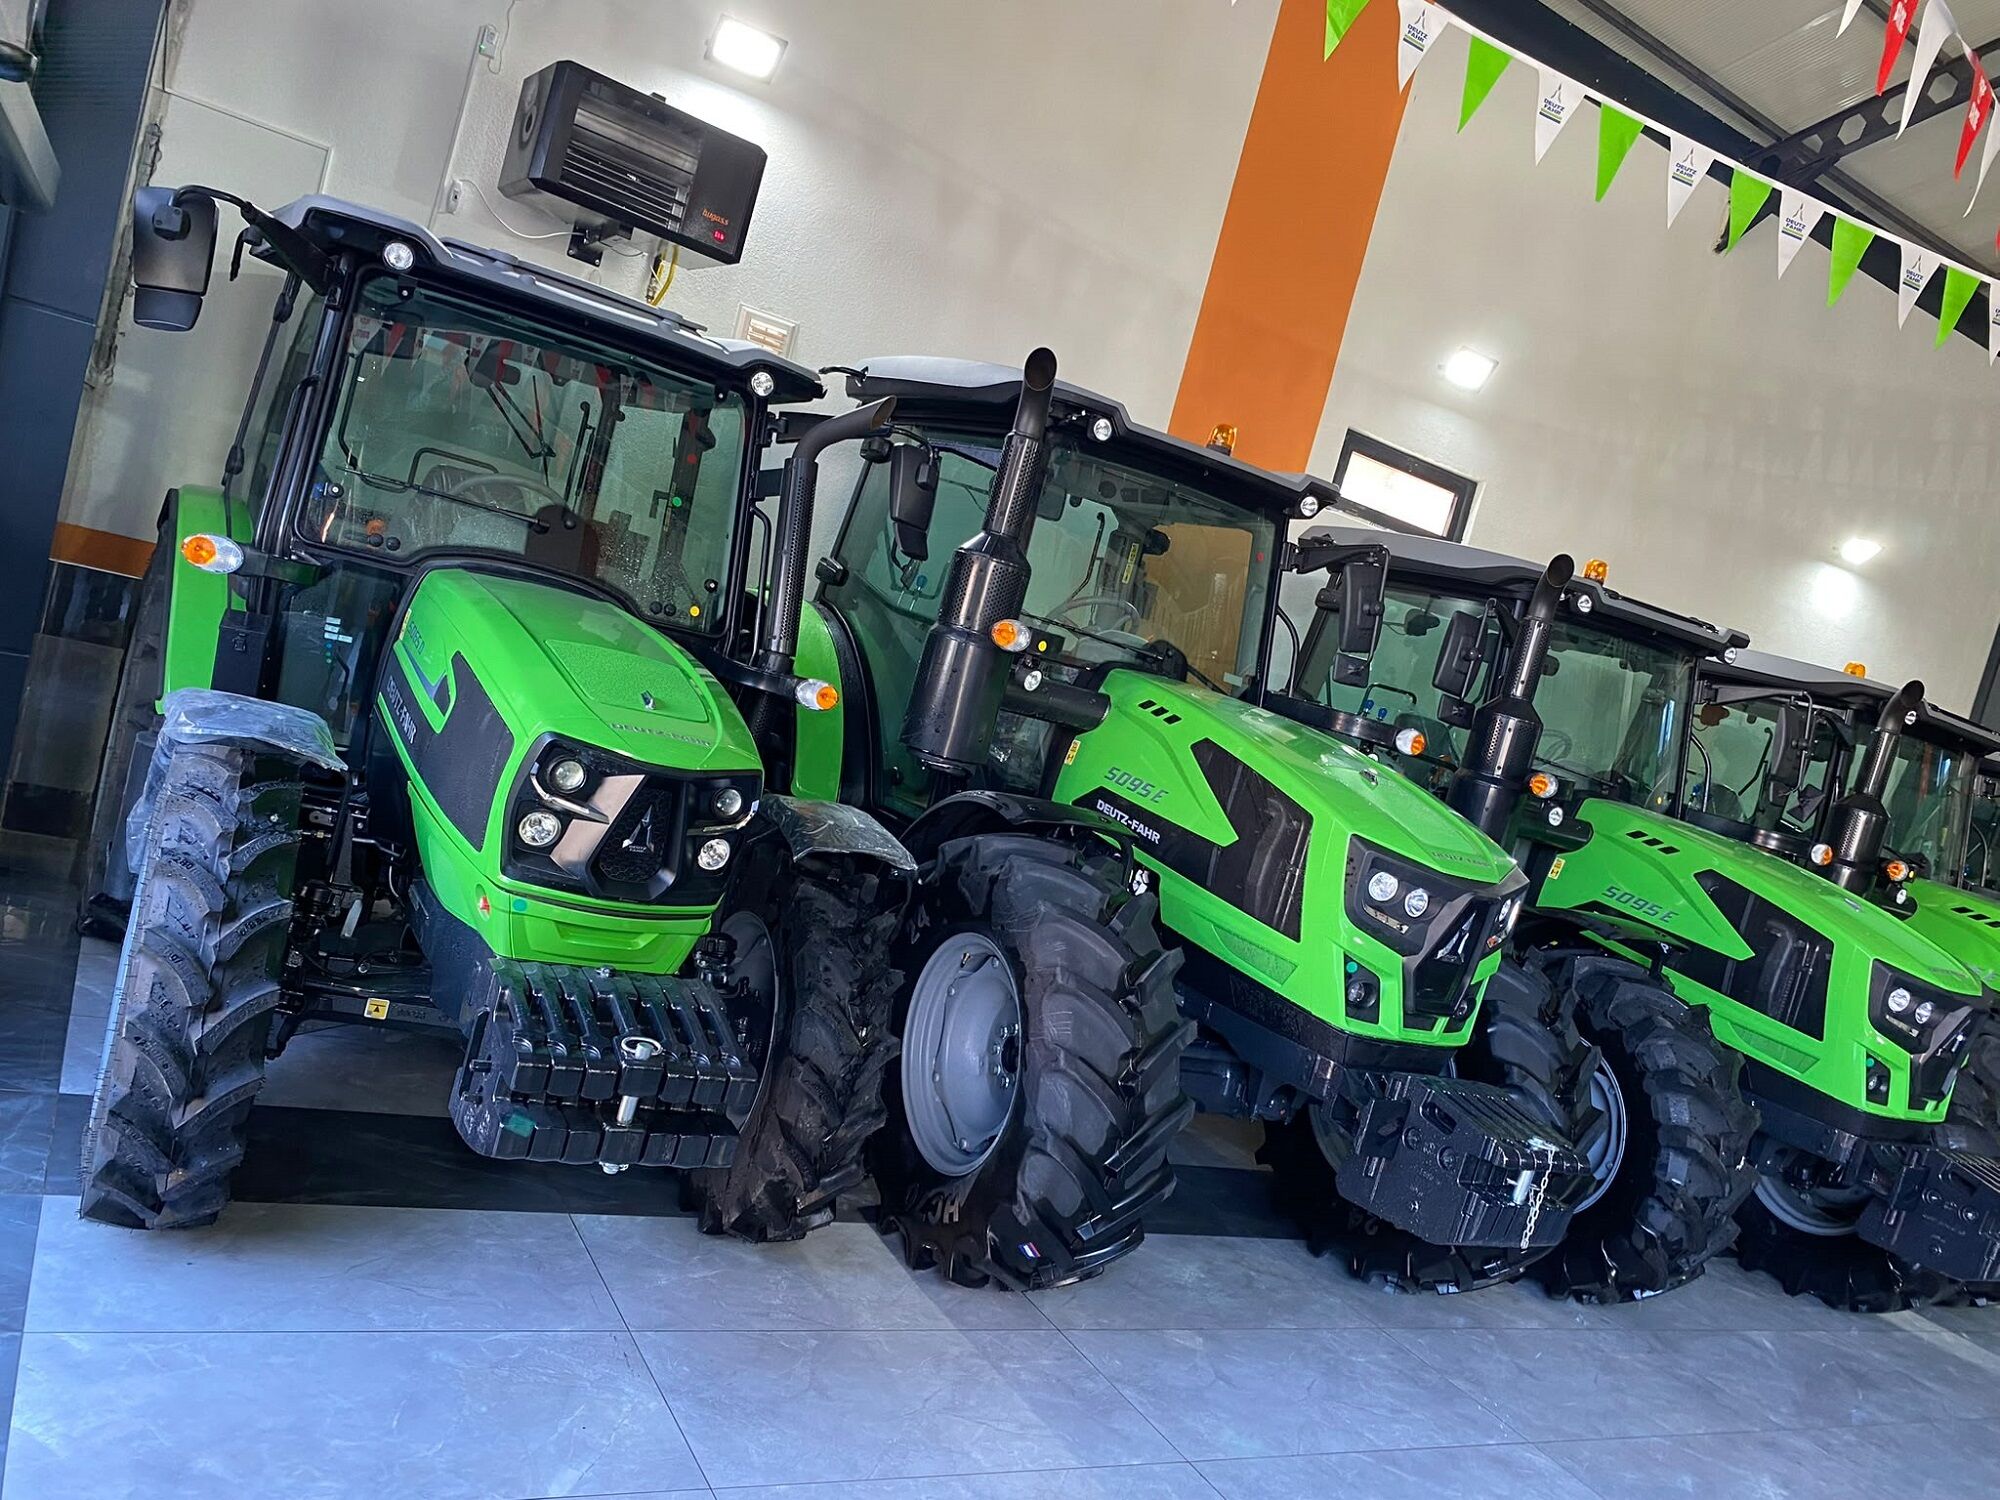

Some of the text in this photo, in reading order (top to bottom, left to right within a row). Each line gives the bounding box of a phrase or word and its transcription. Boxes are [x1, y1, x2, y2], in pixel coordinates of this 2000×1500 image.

[1407, 23, 1429, 39] DEUTZ
[1543, 97, 1565, 112] DEUTZ
[1675, 162, 1698, 175] DEUTZ
[1785, 216, 1807, 230] DEUTZ
[1096, 799, 1161, 844] DEUTZ-FAHR
